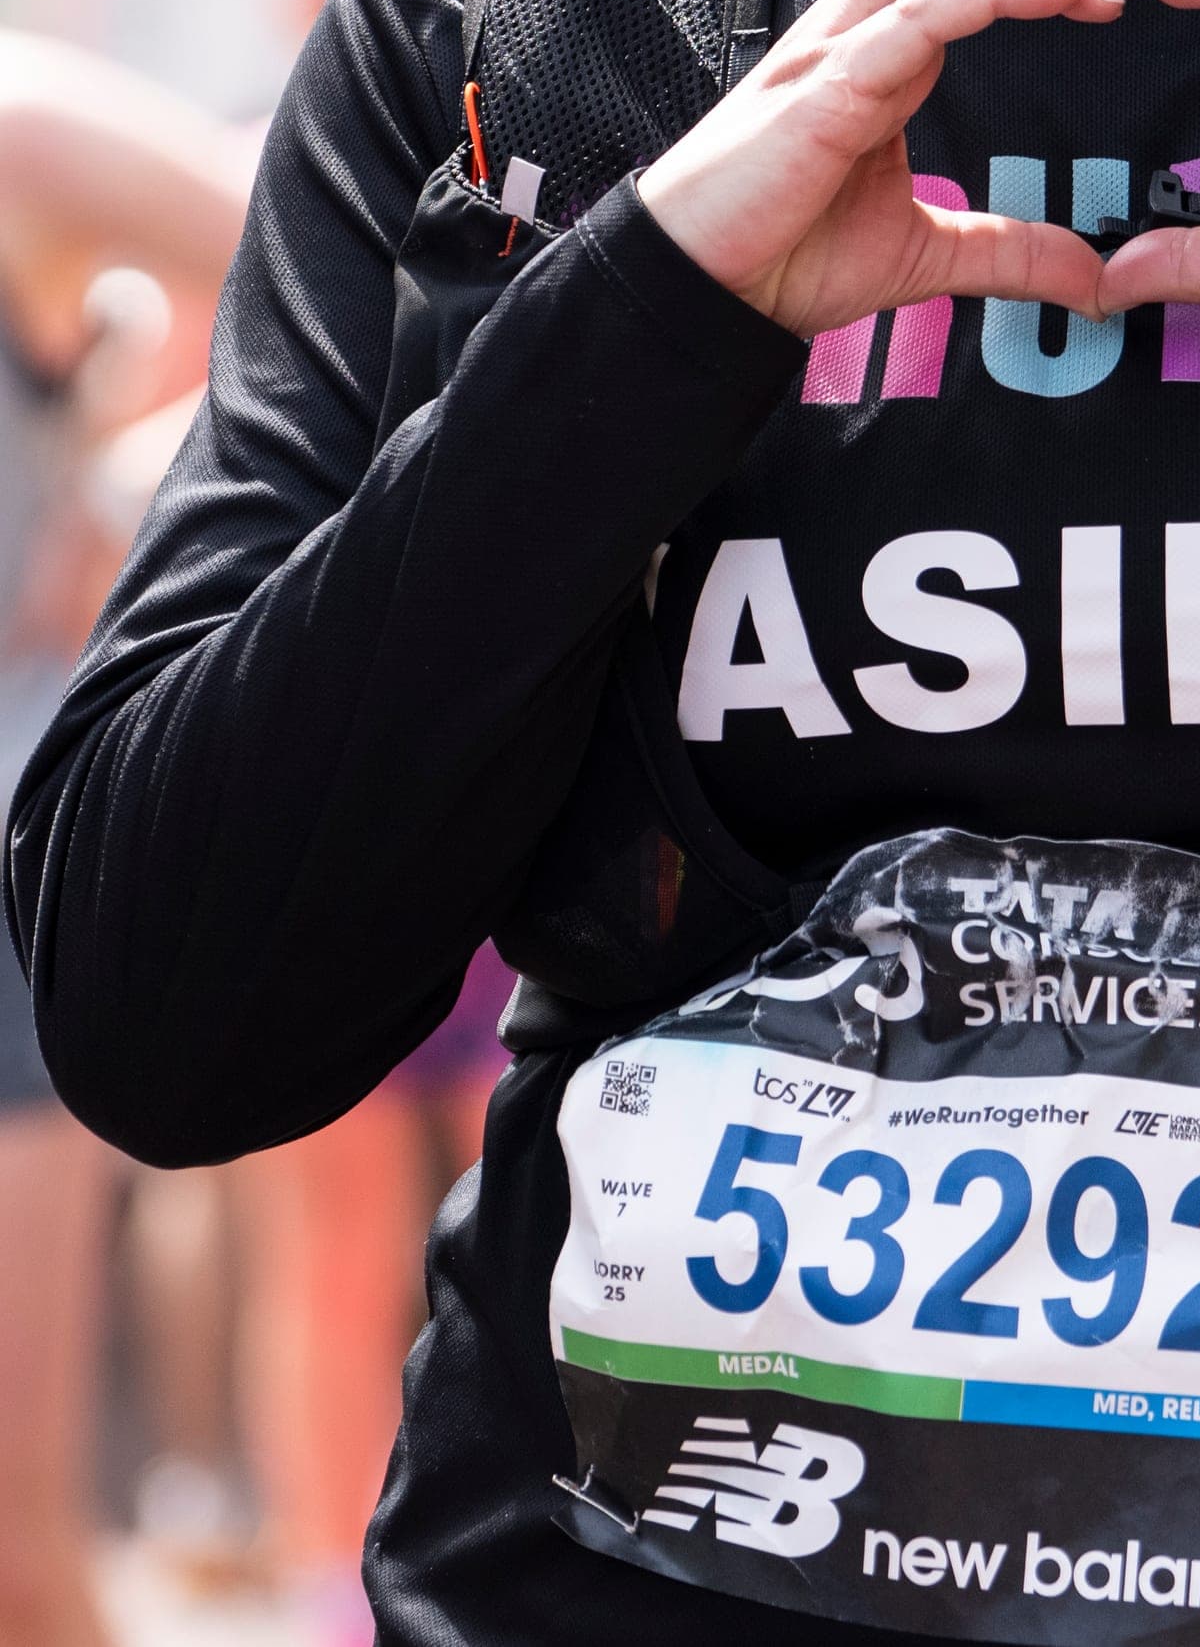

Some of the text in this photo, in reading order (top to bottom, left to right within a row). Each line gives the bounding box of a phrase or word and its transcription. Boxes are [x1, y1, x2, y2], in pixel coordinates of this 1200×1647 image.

[950, 876, 1135, 941] TATA
[753, 1067, 799, 1104] tcs
[888, 1104, 1089, 1128] #WeRunTogether
[600, 1178, 653, 1198] WAVE
[617, 1202, 627, 1218] 7
[603, 1285, 626, 1302] 25
[717, 1353, 800, 1379] MEDAL
[1093, 1392, 1155, 1422] MED,
[862, 1528, 1008, 1592] new
